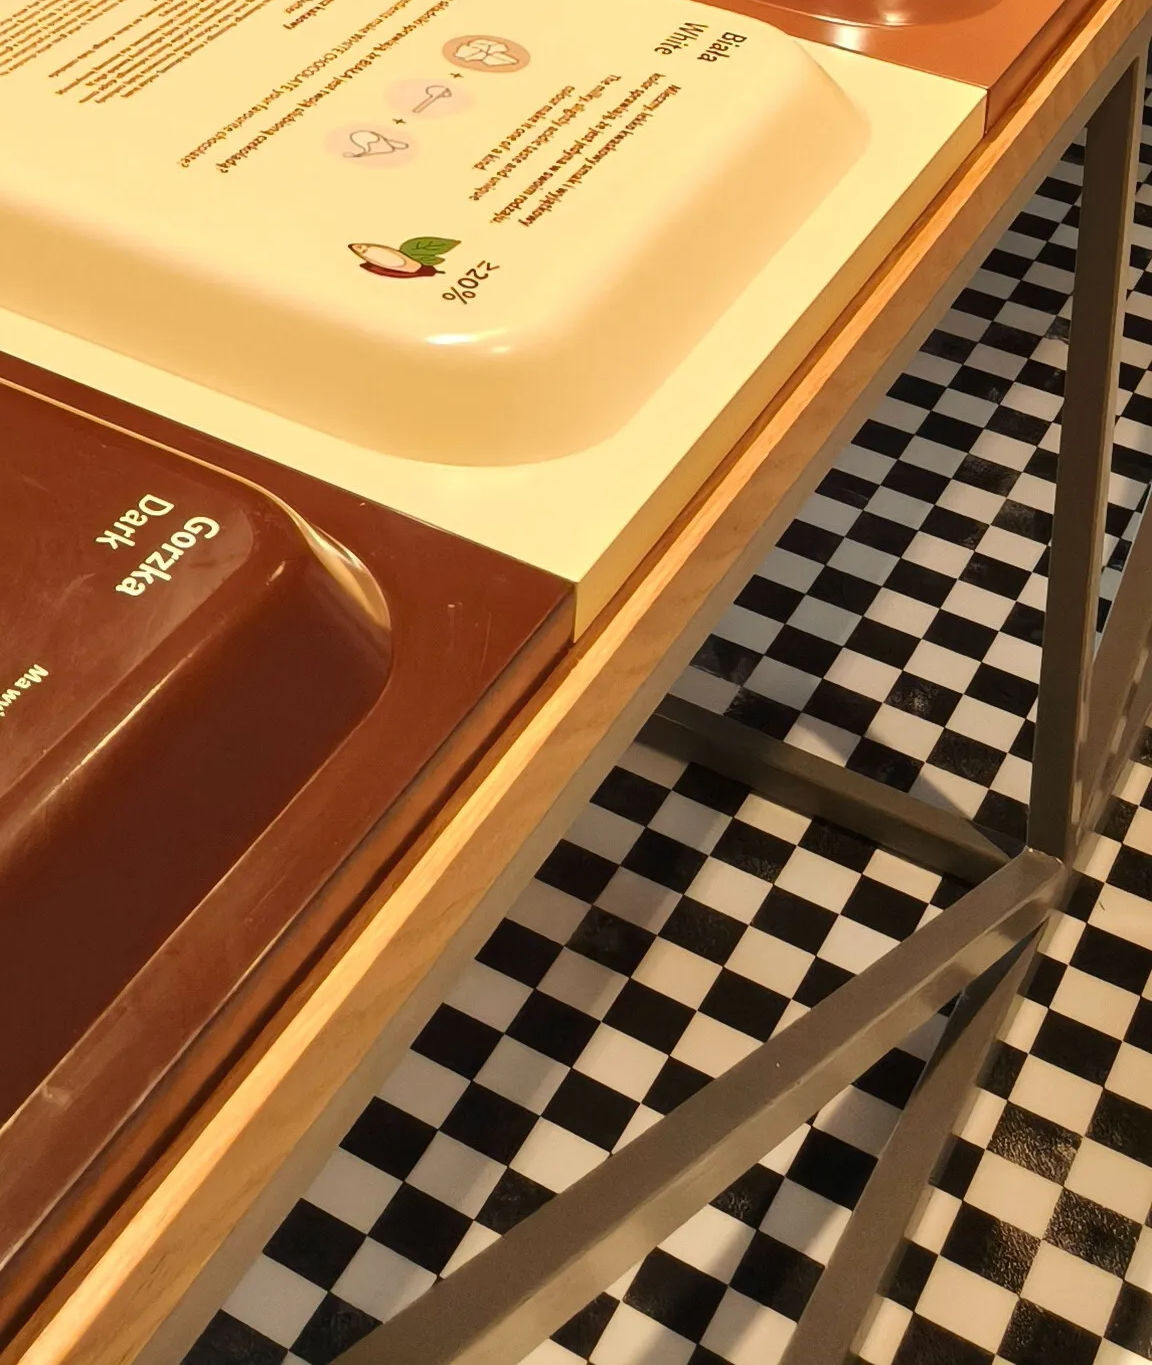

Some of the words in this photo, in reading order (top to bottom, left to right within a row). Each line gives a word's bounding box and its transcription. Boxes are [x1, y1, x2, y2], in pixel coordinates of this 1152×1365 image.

[654, 22, 709, 55] White
[697, 32, 748, 62] Biała
[442, 260, 500, 305] ≥20%
[96, 494, 174, 550] Dark
[115, 516, 220, 596] Gorzka
[14, 664, 49, 689] Ma
